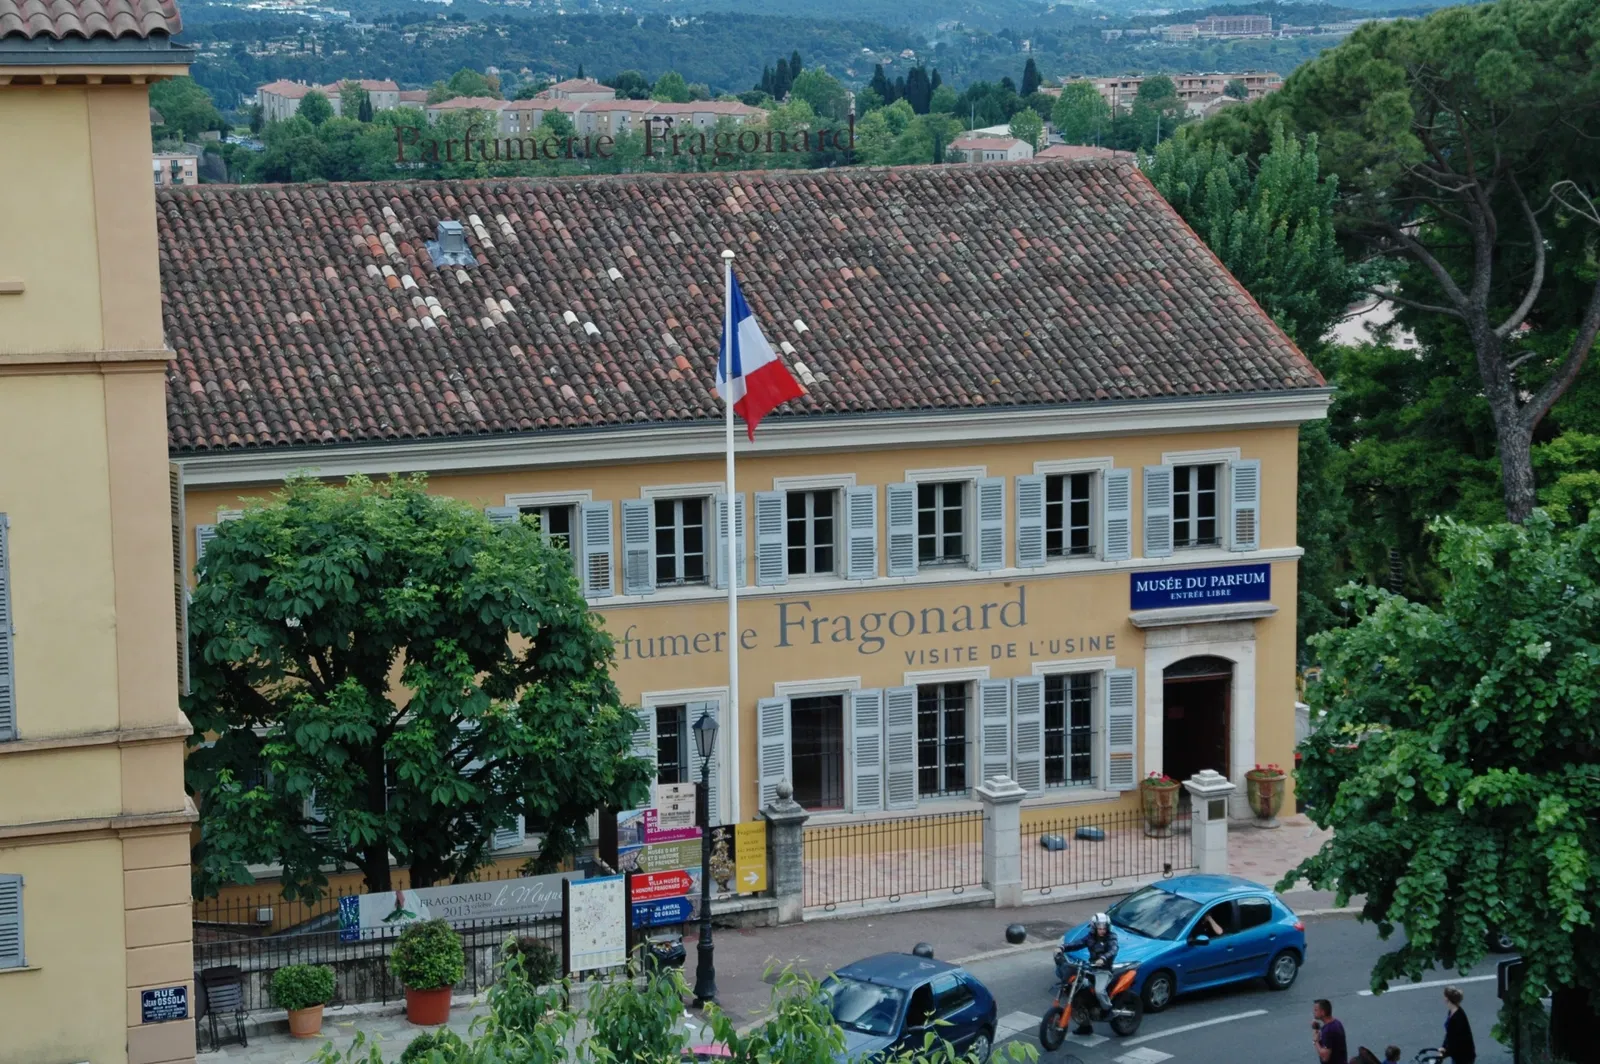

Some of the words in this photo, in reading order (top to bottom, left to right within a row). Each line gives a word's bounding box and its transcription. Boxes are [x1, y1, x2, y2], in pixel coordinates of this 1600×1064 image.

[394, 123, 614, 163] Parfumerie
[639, 113, 856, 167] Fragonard
[1136, 576, 1183, 592] MUSÉE
[1186, 577, 1207, 589] DU
[1211, 572, 1266, 587] PARFUM
[1170, 590, 1204, 600] ENTRÉE
[1206, 588, 1232, 597] LIBRE
[774, 584, 1027, 655] Fragonard
[904, 646, 979, 666] VISITE
[990, 643, 1018, 660] DE
[1029, 634, 1117, 657] L'USINE
[420, 892, 492, 908] FRAGONARD
[443, 904, 471, 918] 2013
[154, 989, 175, 998] RUE
[157, 995, 186, 1006] OSSOLA
